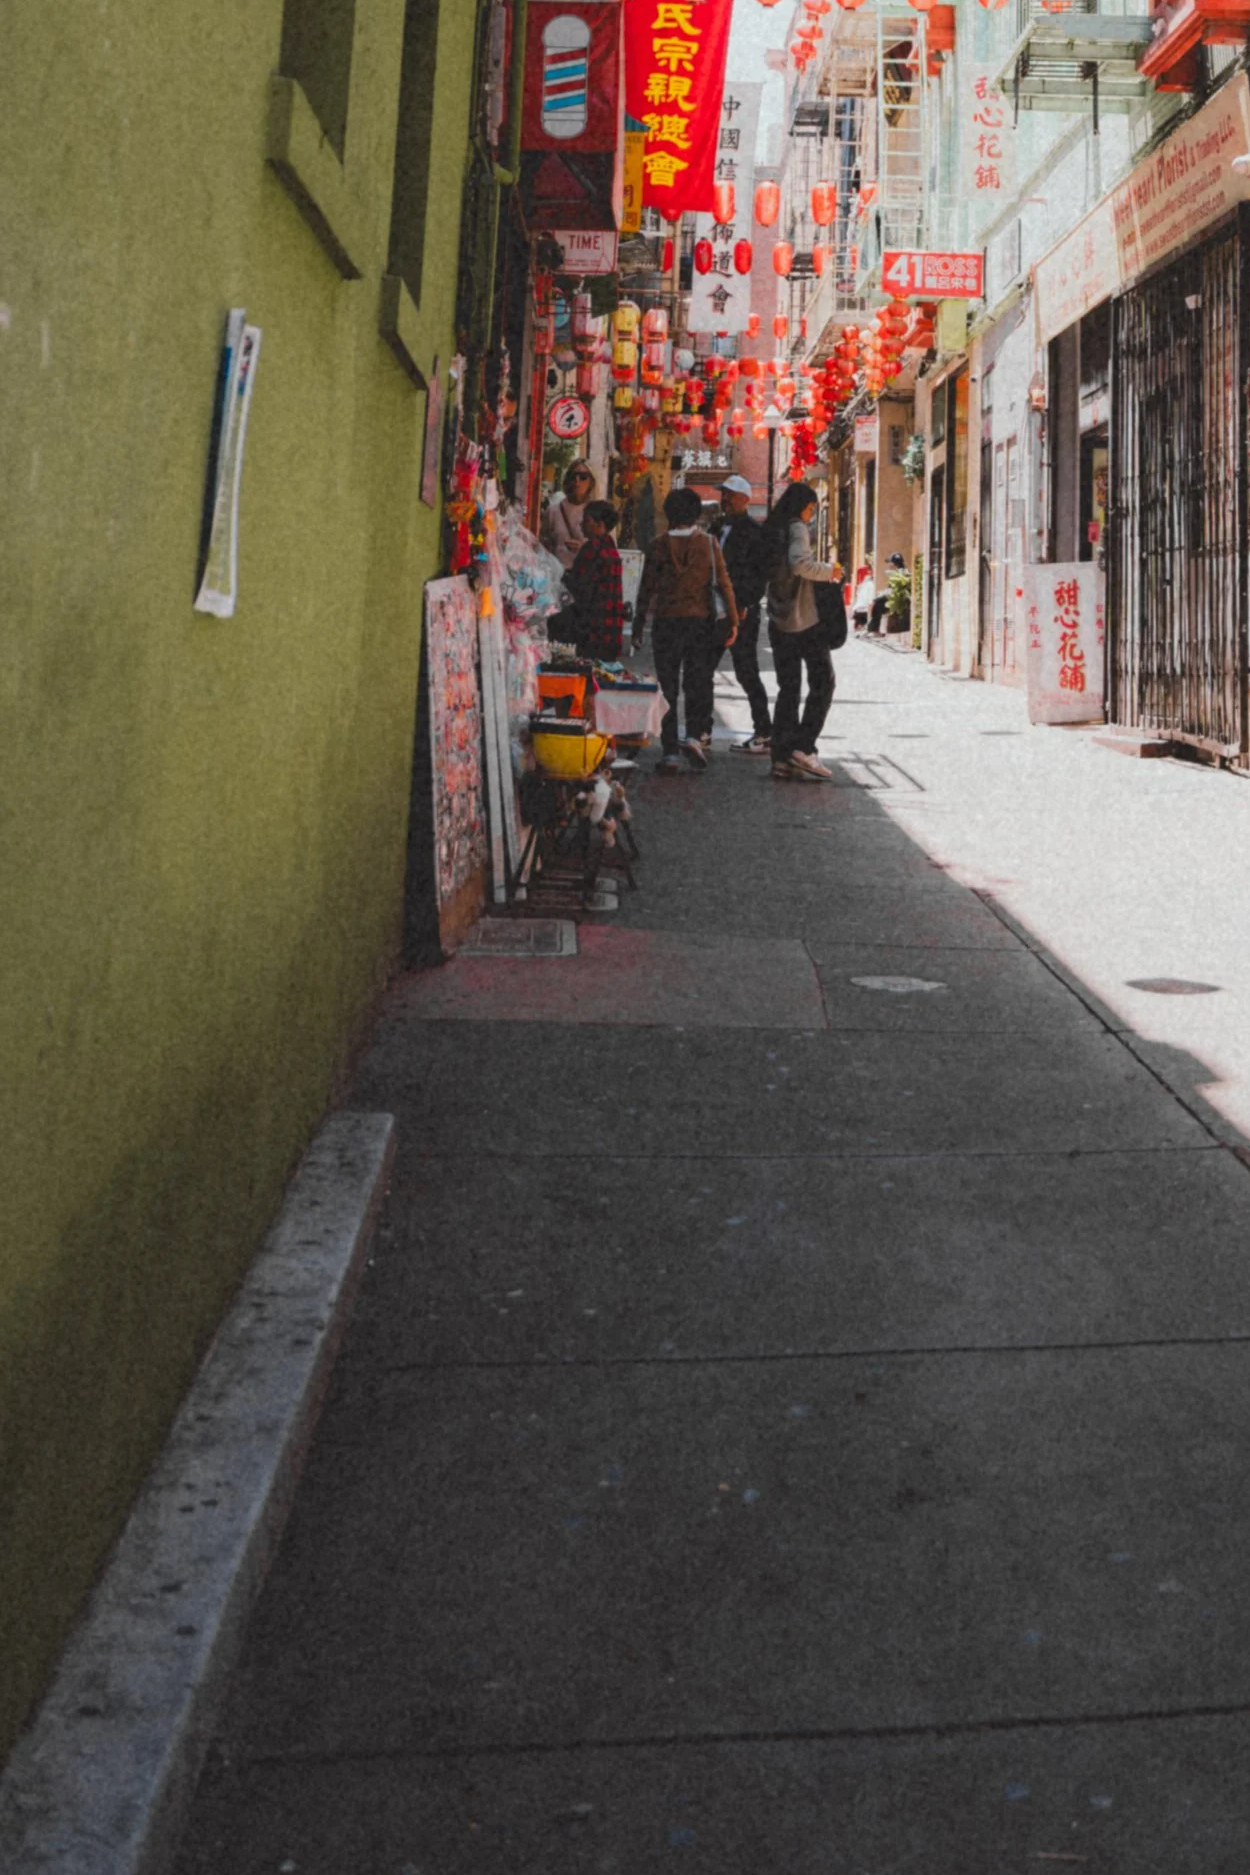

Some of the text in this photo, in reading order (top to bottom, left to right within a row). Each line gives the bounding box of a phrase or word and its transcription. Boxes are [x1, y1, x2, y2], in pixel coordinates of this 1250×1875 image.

[707, 95, 742, 315] 中國信佈道會
[568, 234, 601, 250] TIME
[887, 255, 978, 288] 41 ROSS
[1053, 579, 1086, 692] 甜心花舖
